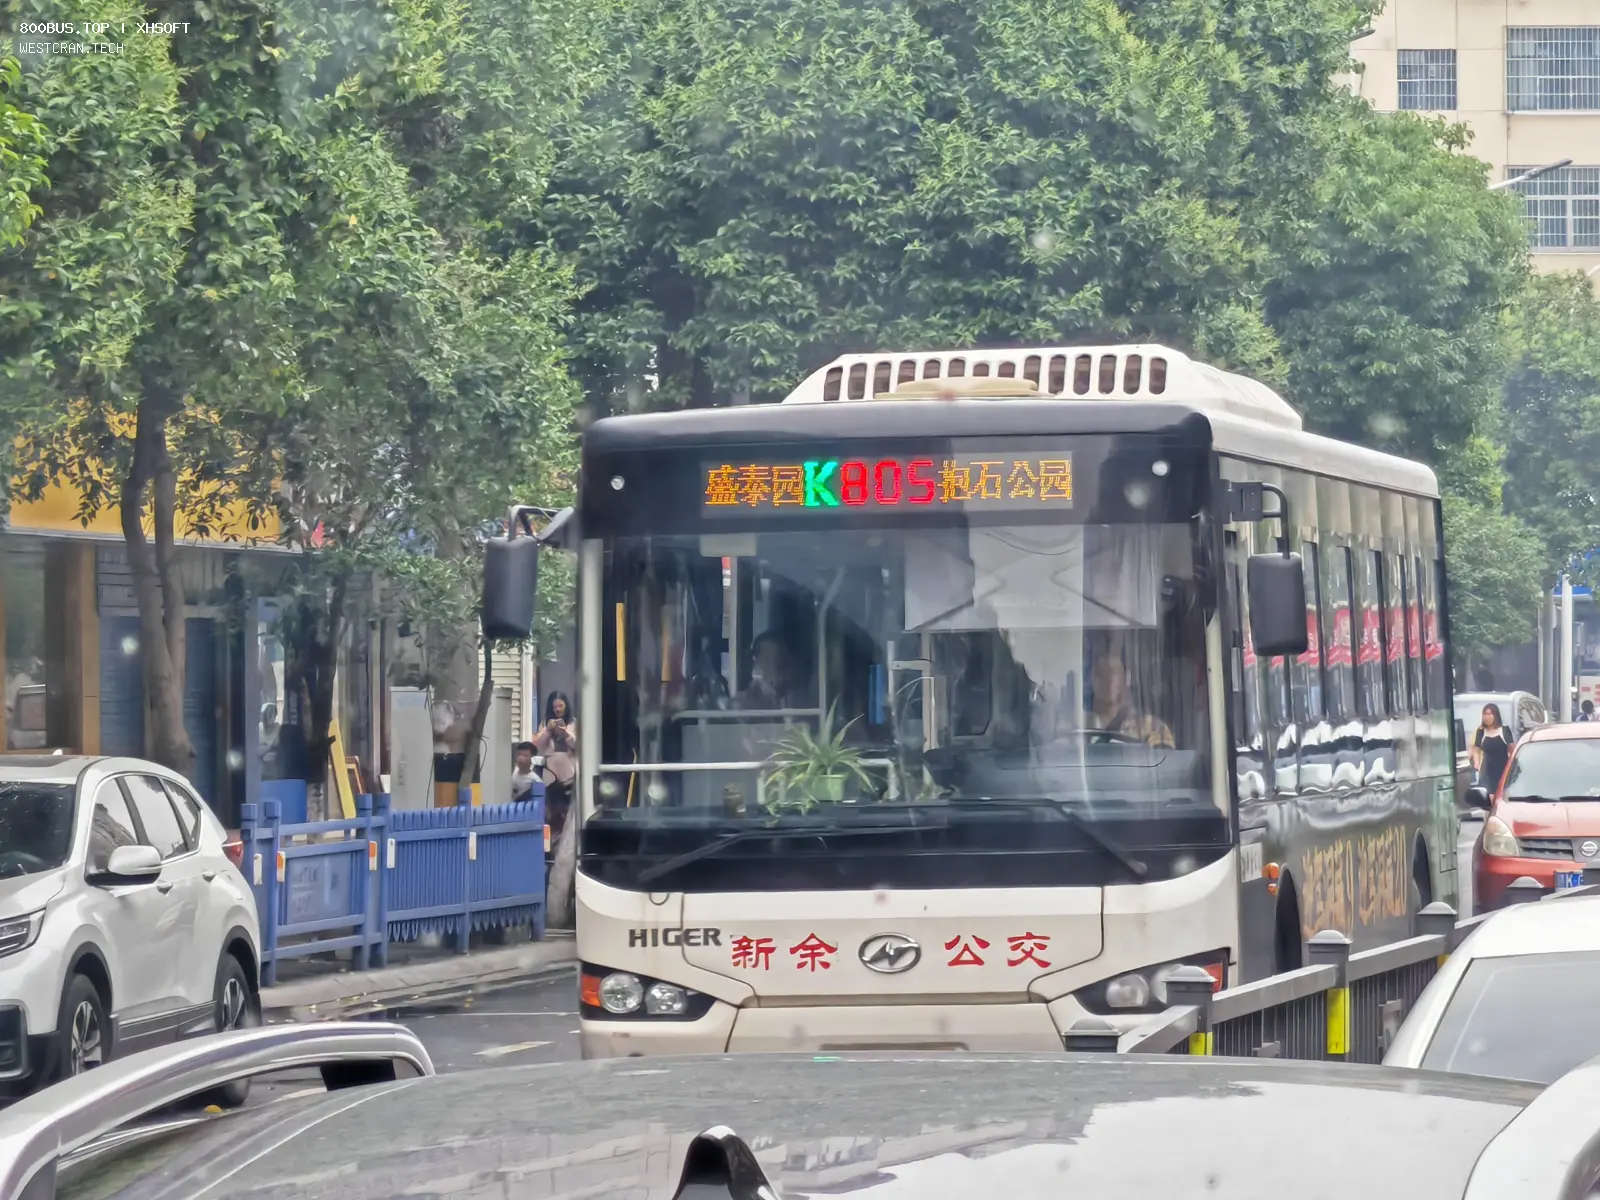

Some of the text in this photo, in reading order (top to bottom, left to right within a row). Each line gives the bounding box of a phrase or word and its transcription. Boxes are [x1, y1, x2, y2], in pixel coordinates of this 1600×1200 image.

[705, 459, 1073, 506] 盛泰园 K805 抱石公园
[628, 927, 721, 947] HIGER
[732, 932, 1052, 972] 新余 公交
